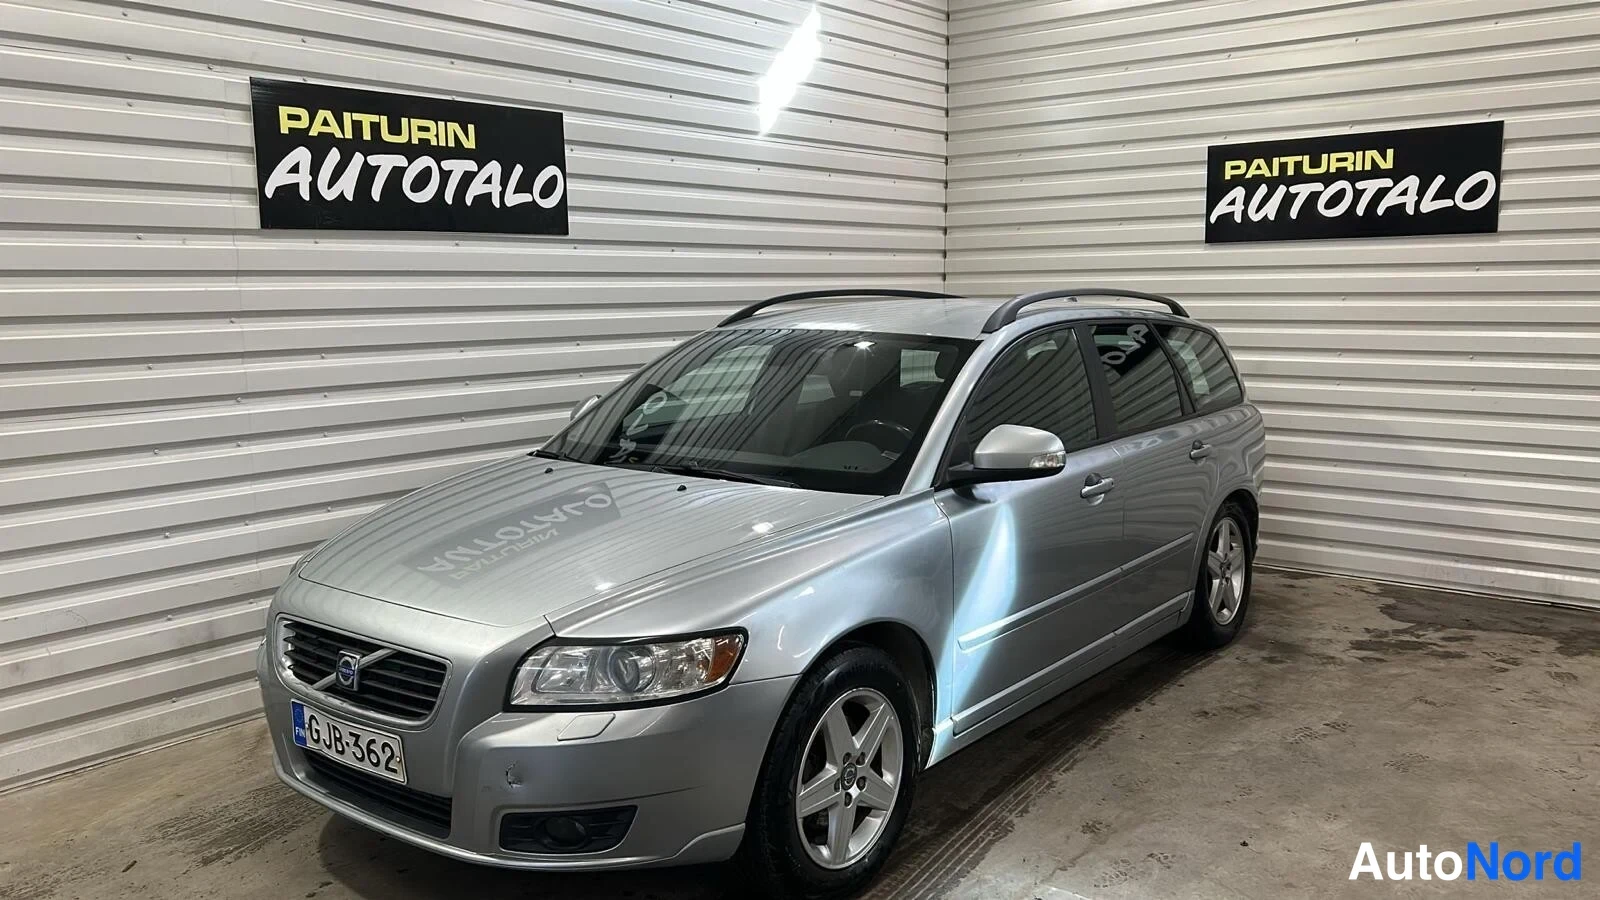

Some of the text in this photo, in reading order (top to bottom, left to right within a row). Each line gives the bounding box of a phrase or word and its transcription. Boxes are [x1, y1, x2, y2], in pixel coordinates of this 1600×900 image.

[278, 105, 476, 149] PAITURIN
[264, 146, 564, 209] AUTOTALO
[1224, 149, 1394, 180] PAITURIN
[1209, 170, 1497, 224] AUTOTALO
[295, 726, 306, 738] FIN
[309, 714, 398, 774] GJB-362
